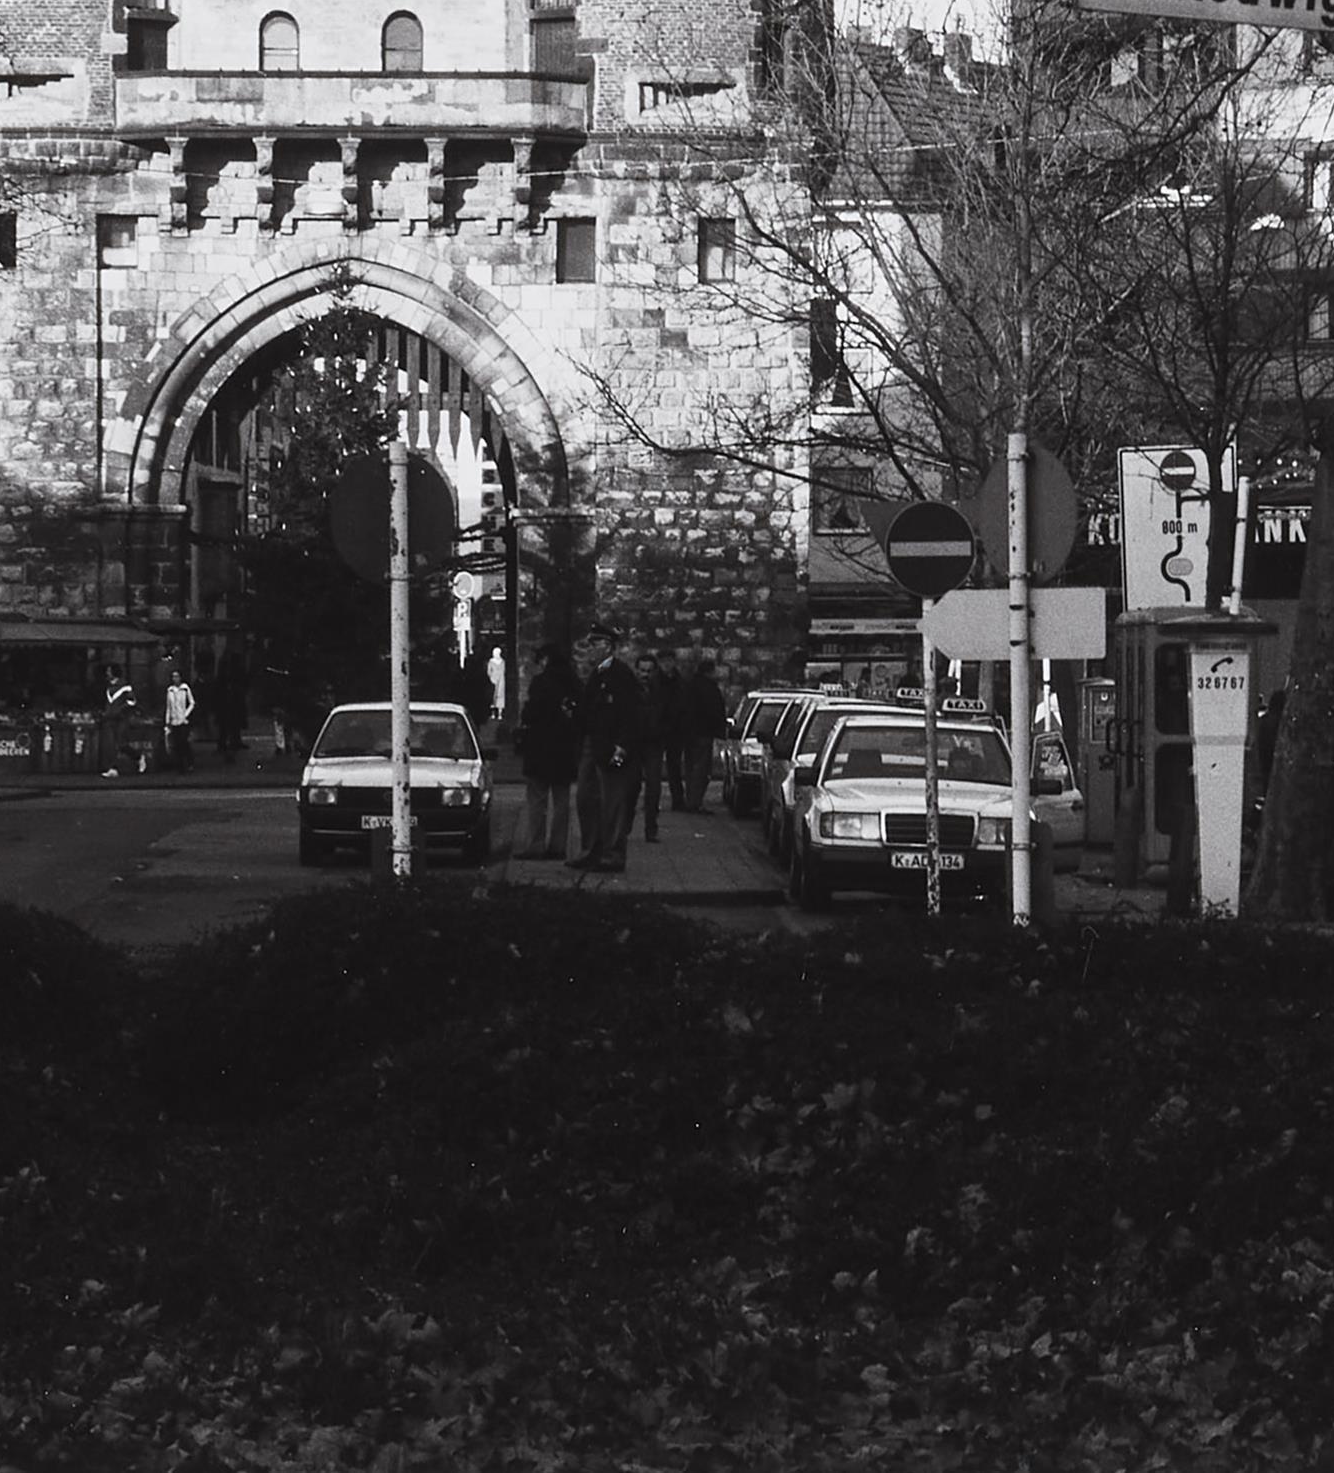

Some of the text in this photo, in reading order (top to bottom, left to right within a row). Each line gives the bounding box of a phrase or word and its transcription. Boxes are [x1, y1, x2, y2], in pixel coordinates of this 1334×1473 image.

[1162, 520, 1198, 535] 800 m
[1197, 676, 1245, 690] 326767
[950, 700, 982, 709] TAXI
